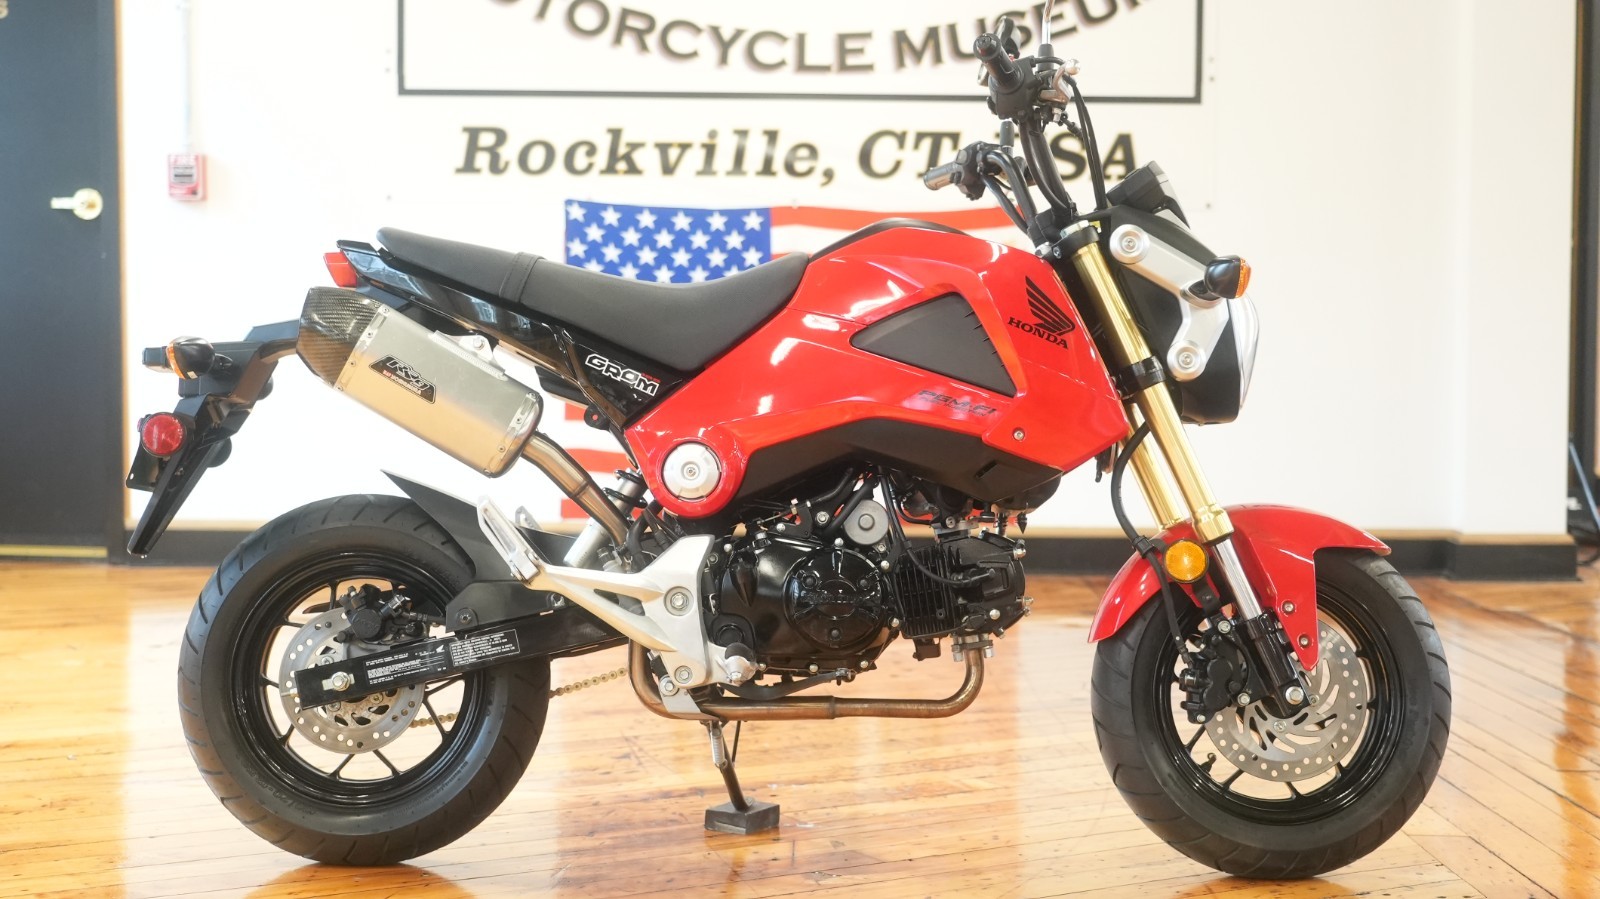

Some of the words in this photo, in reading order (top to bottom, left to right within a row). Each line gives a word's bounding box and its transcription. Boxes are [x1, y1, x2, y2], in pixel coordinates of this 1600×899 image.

[490, 0, 874, 73] ORCYCLE
[894, 0, 1144, 68] MUSEU
[454, 126, 835, 187] Rockville,
[995, 131, 1137, 182] SA
[1007, 316, 1069, 349] HONDA
[585, 353, 660, 397] GROM
